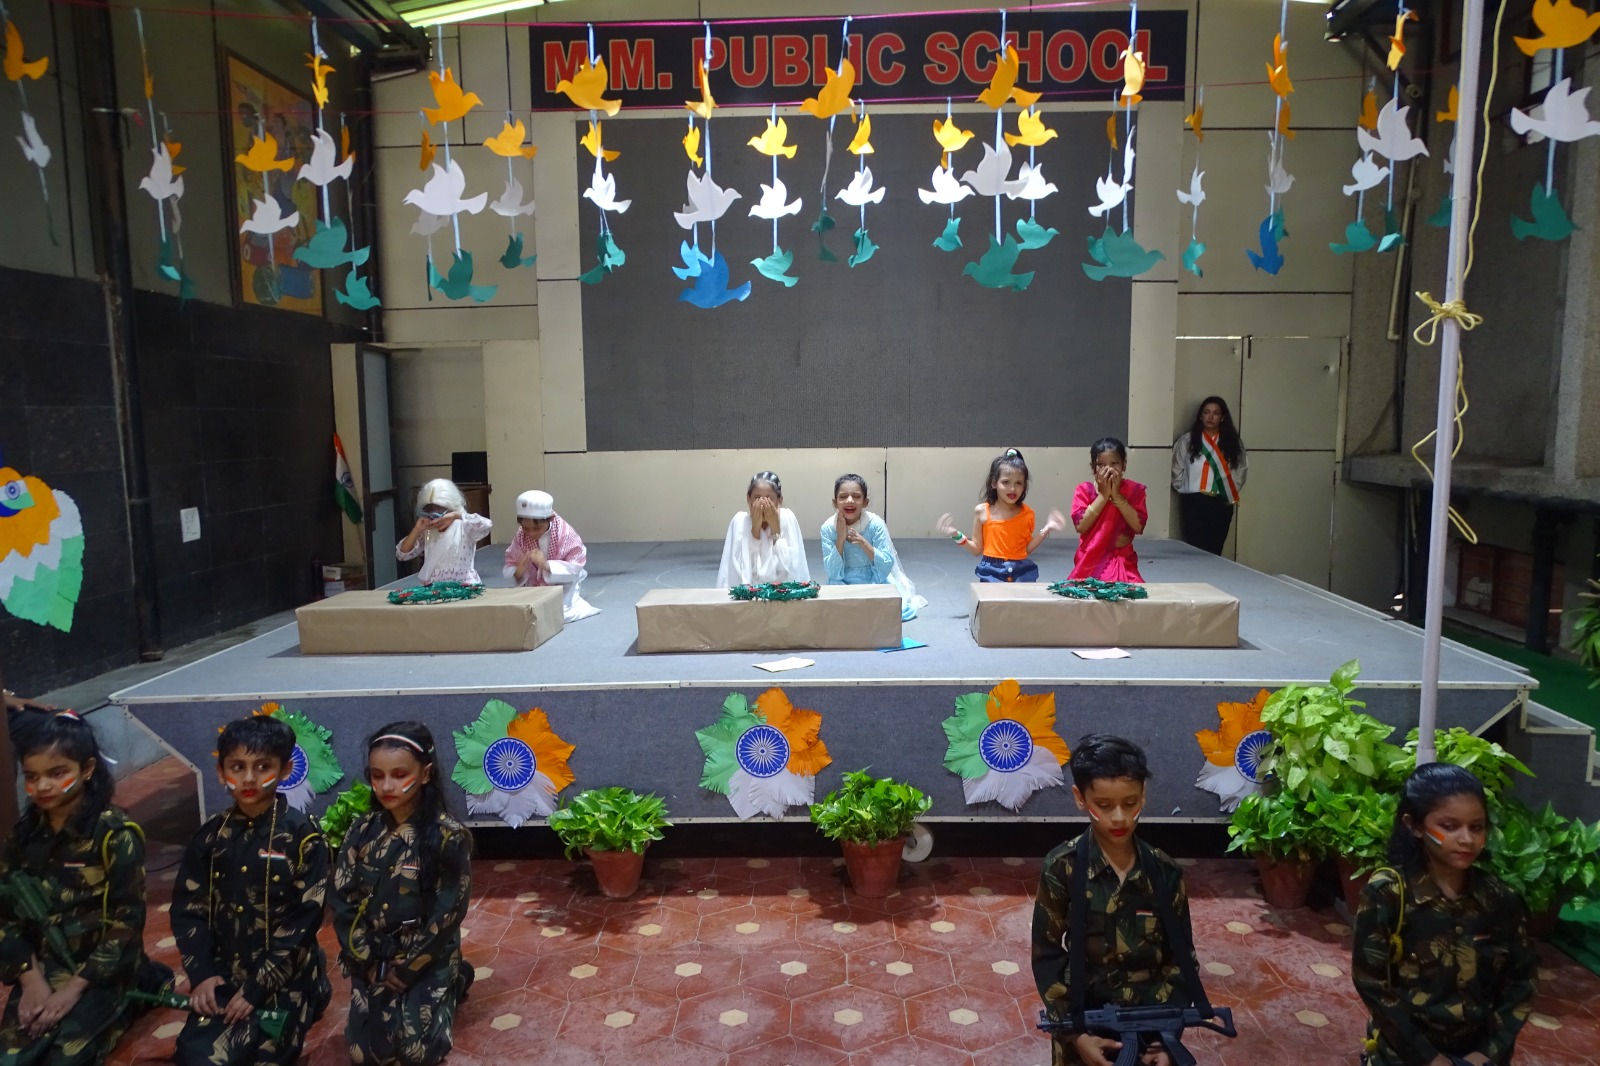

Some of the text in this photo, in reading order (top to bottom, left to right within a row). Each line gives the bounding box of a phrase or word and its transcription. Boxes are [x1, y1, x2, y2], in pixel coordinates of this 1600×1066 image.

[543, 29, 1168, 92] MM. PUBLIC SCHOOL
